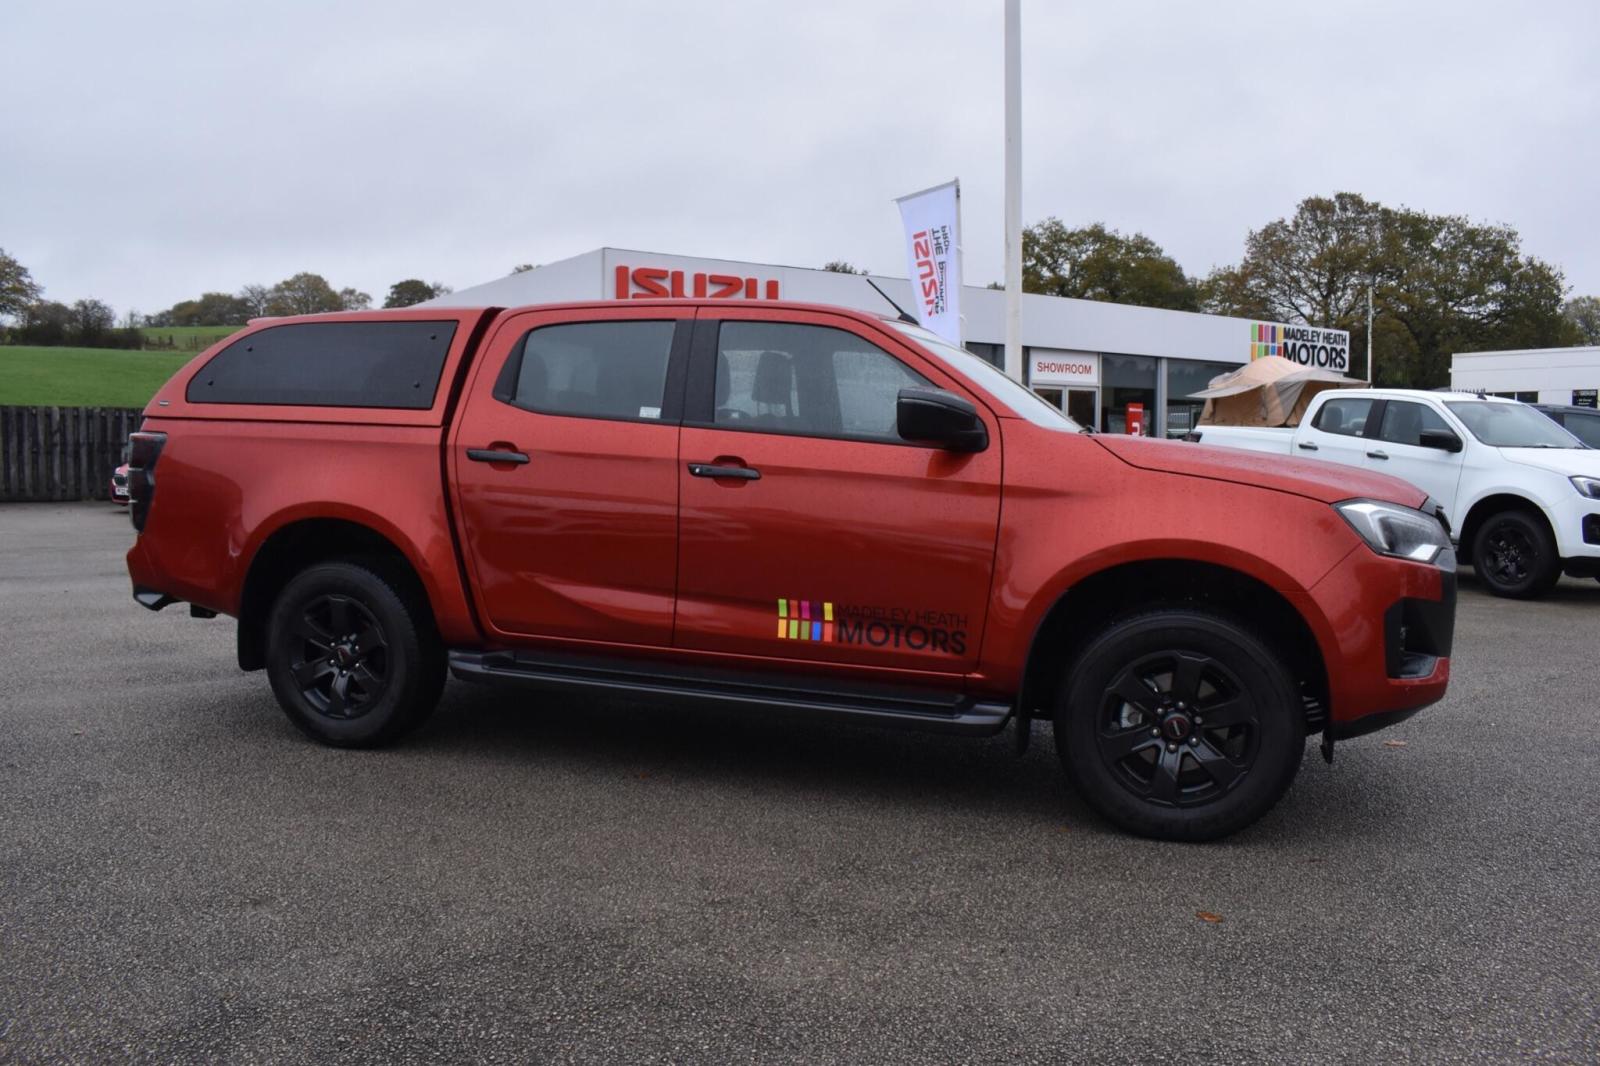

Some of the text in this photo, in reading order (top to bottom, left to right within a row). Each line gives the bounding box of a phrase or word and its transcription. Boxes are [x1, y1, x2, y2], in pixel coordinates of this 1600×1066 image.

[616, 265, 779, 299] ISUZU
[1283, 326, 1347, 346] MADELEY HEATH
[1037, 362, 1092, 375] SHOWROOM
[1283, 341, 1347, 369] MOTORS
[838, 602, 967, 628] MADELEY HEATH
[838, 619, 967, 655] MOTORS
